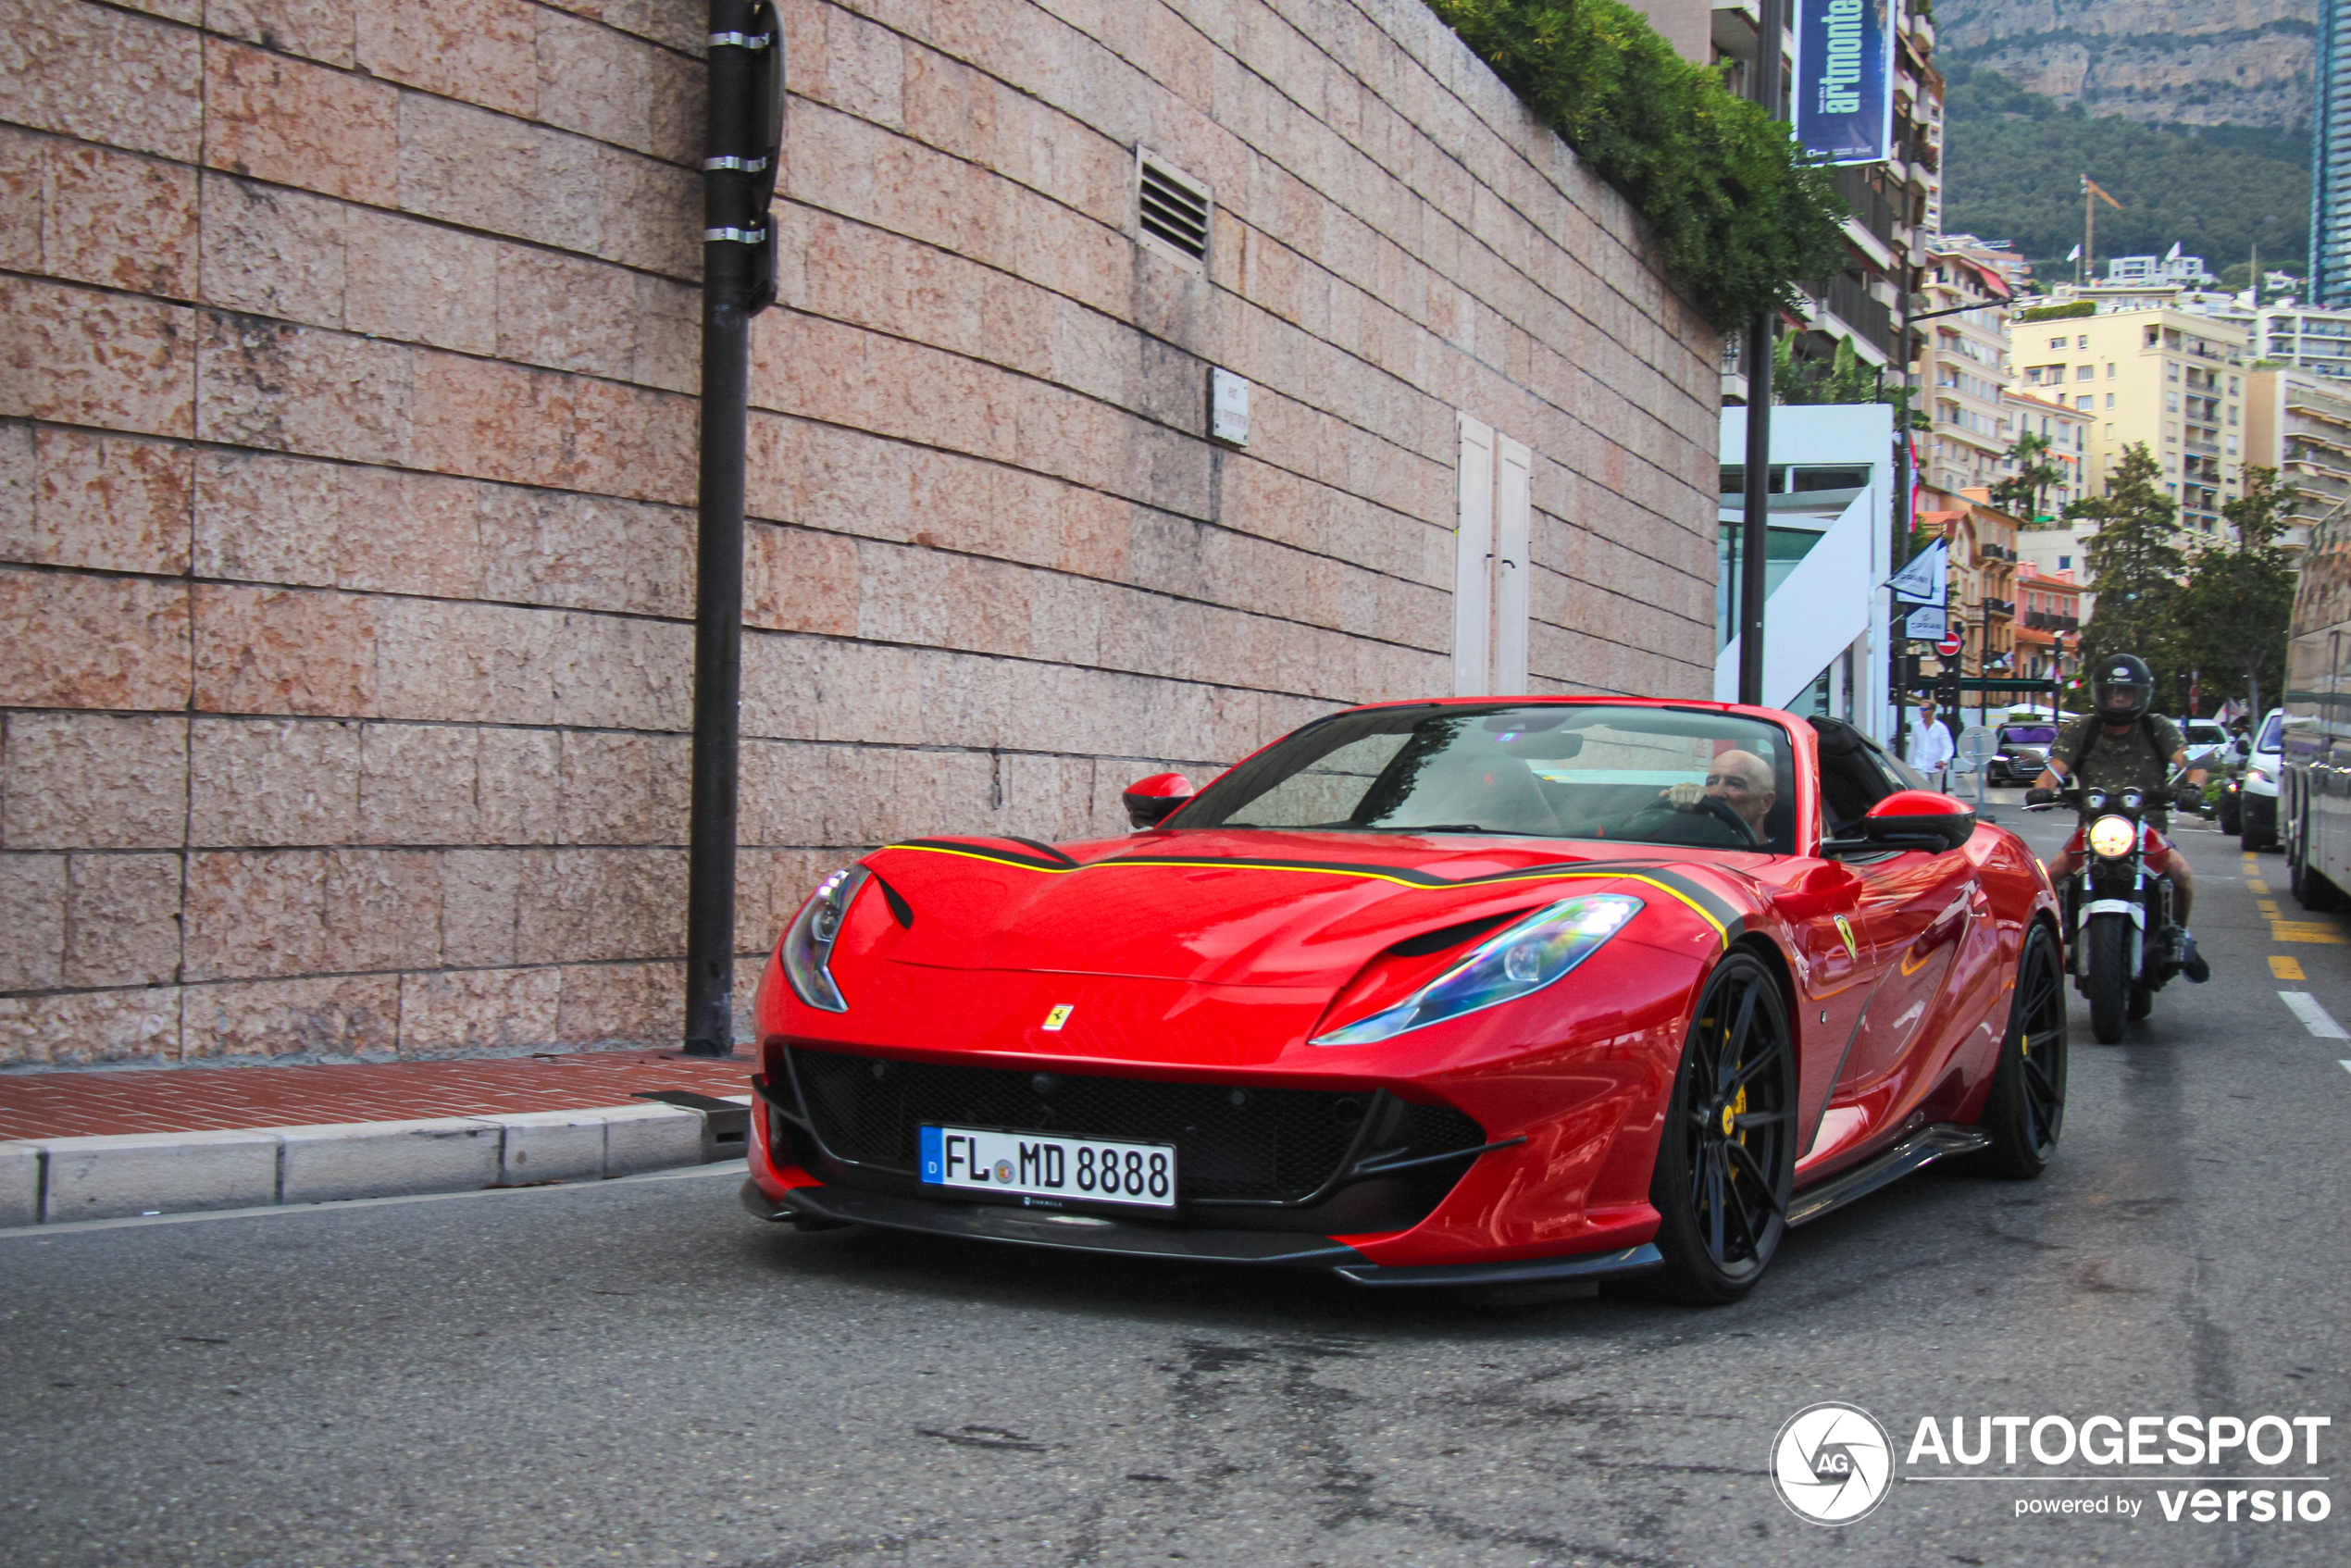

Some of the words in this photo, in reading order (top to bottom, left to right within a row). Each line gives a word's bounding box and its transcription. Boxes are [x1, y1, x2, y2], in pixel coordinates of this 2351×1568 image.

[927, 1161, 938, 1174] D
[945, 1135, 990, 1181] FL
[1019, 1140, 1065, 1188] MD
[1076, 1146, 1169, 1198] 8888
